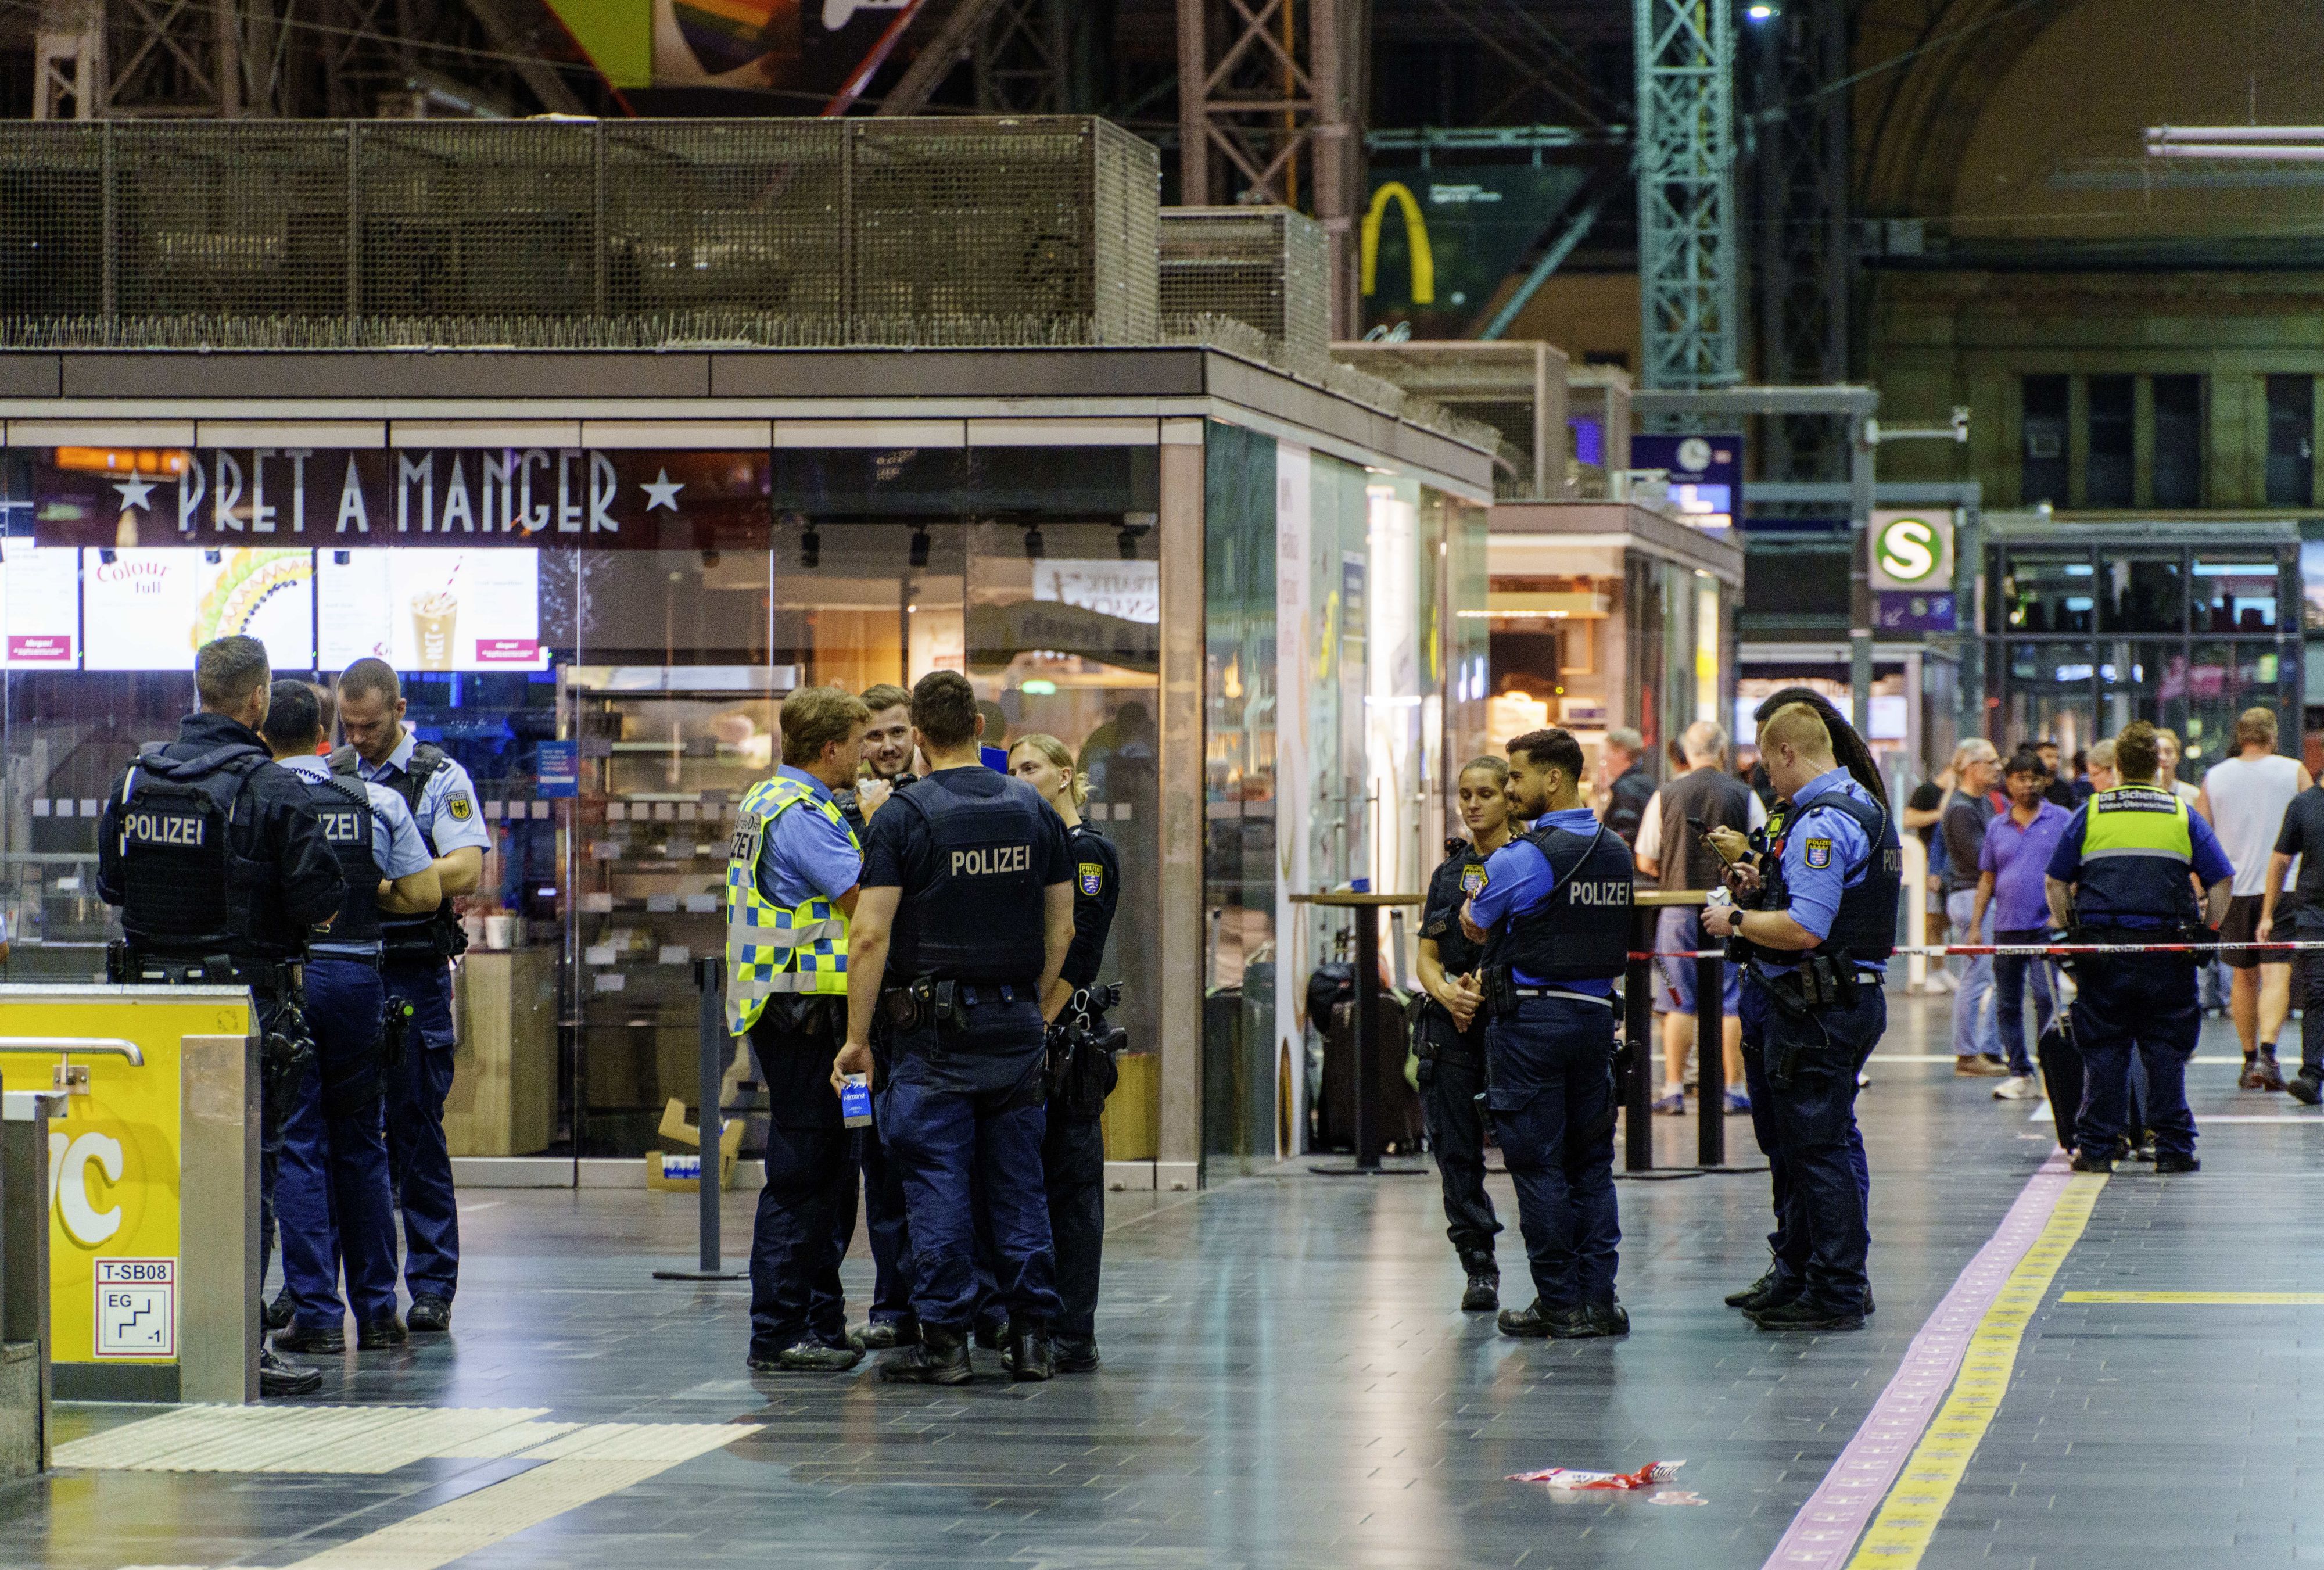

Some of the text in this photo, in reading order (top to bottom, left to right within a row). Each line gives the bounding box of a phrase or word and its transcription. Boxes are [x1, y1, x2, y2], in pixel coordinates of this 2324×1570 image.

[178, 449, 618, 532] PRET A MANGER
[1882, 521, 1932, 579] S
[97, 561, 172, 581] Colour
[137, 581, 160, 593] full
[447, 792, 467, 801] POLIZEI
[2099, 793, 2116, 802] DB
[125, 814, 202, 845] POLIZEI
[952, 845, 1030, 876] POLIZEI
[1081, 865, 1101, 873] POLIZEI
[1570, 881, 1630, 905] POLIZEI
[103, 1264, 166, 1279] T-SB08
[109, 1295, 131, 1307] EG
[148, 1329, 160, 1342] -1
